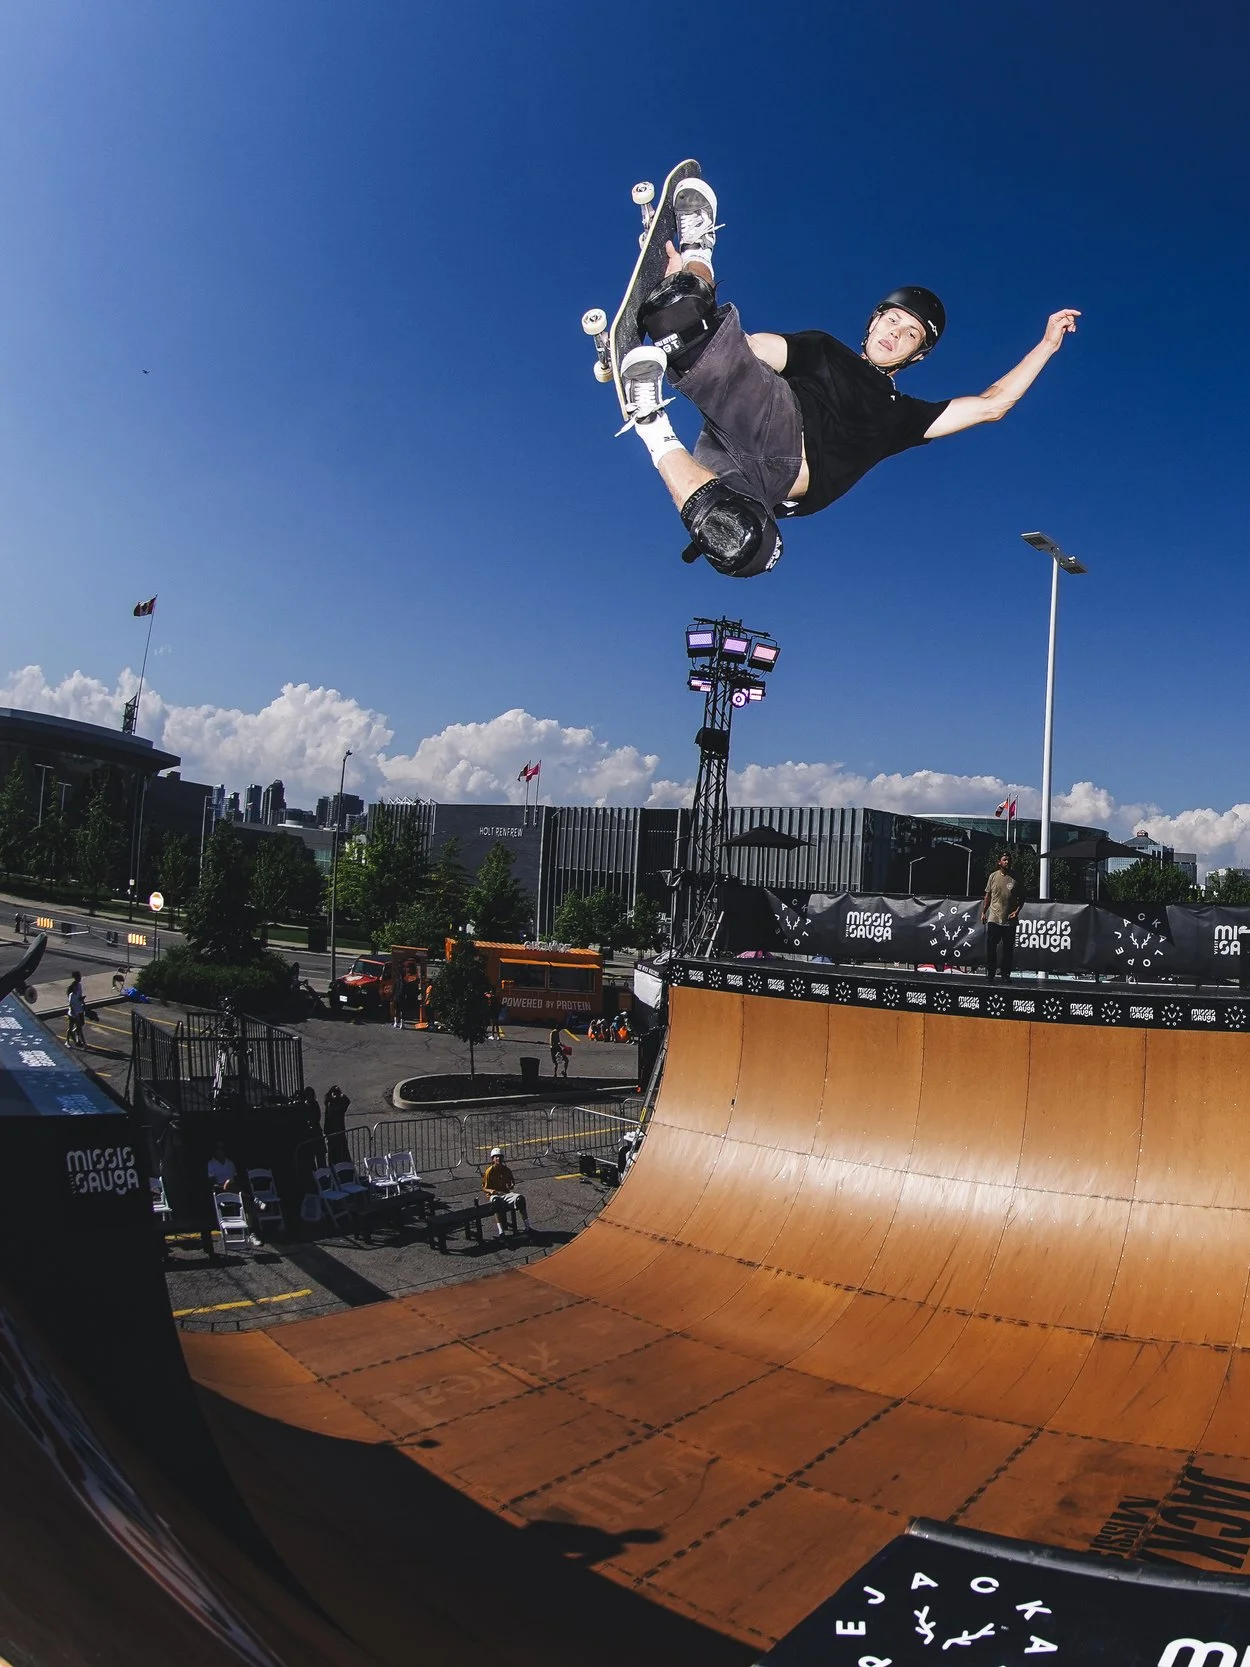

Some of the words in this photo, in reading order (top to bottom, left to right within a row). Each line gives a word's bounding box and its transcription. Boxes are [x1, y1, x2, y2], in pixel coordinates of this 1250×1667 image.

[480, 826, 494, 836] HOLT
[495, 827, 523, 838] RENFREW
[929, 906, 975, 958] JACKALOPE
[1114, 912, 1168, 968] JACKALOPE
[501, 997, 543, 1009] POWERED
[556, 1000, 592, 1011] PROTEIN
